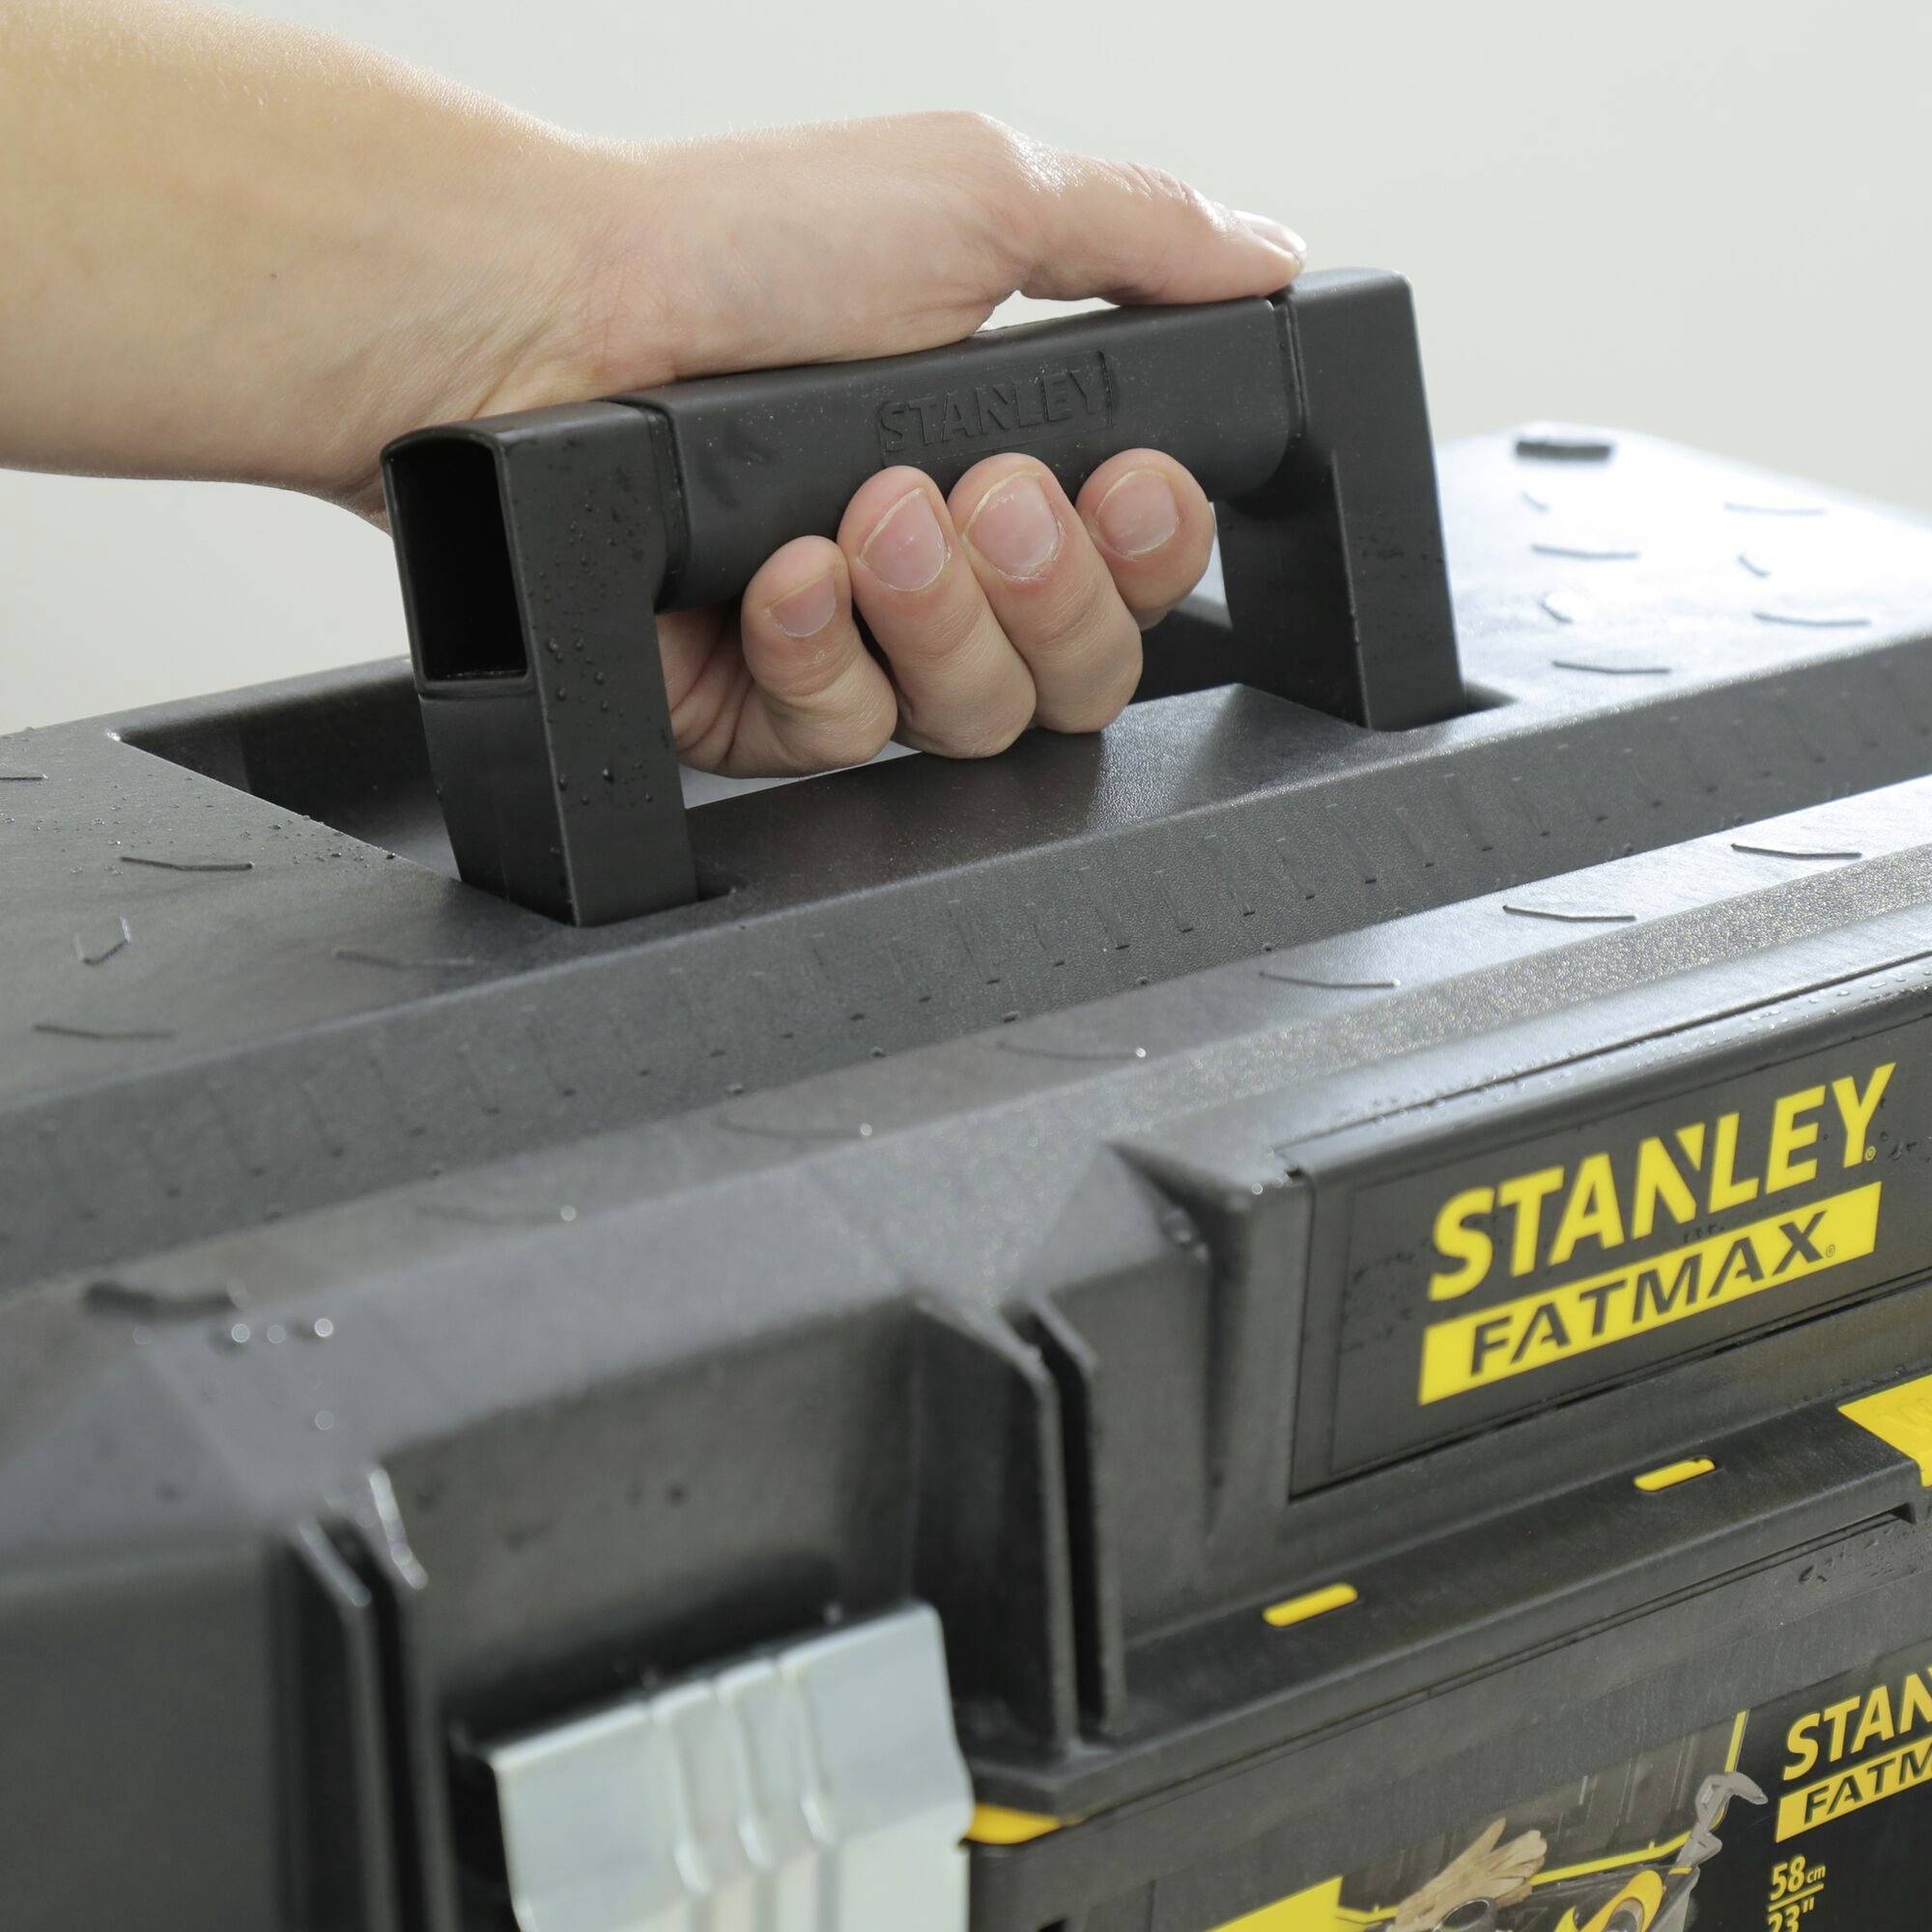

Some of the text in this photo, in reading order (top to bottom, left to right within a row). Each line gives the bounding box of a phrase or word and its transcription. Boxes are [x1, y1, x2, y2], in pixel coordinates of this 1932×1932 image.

[878, 365, 1105, 453] STANLEY
[1428, 1062, 1897, 1302] STANLEY
[1468, 1209, 1829, 1378] FATMAX
